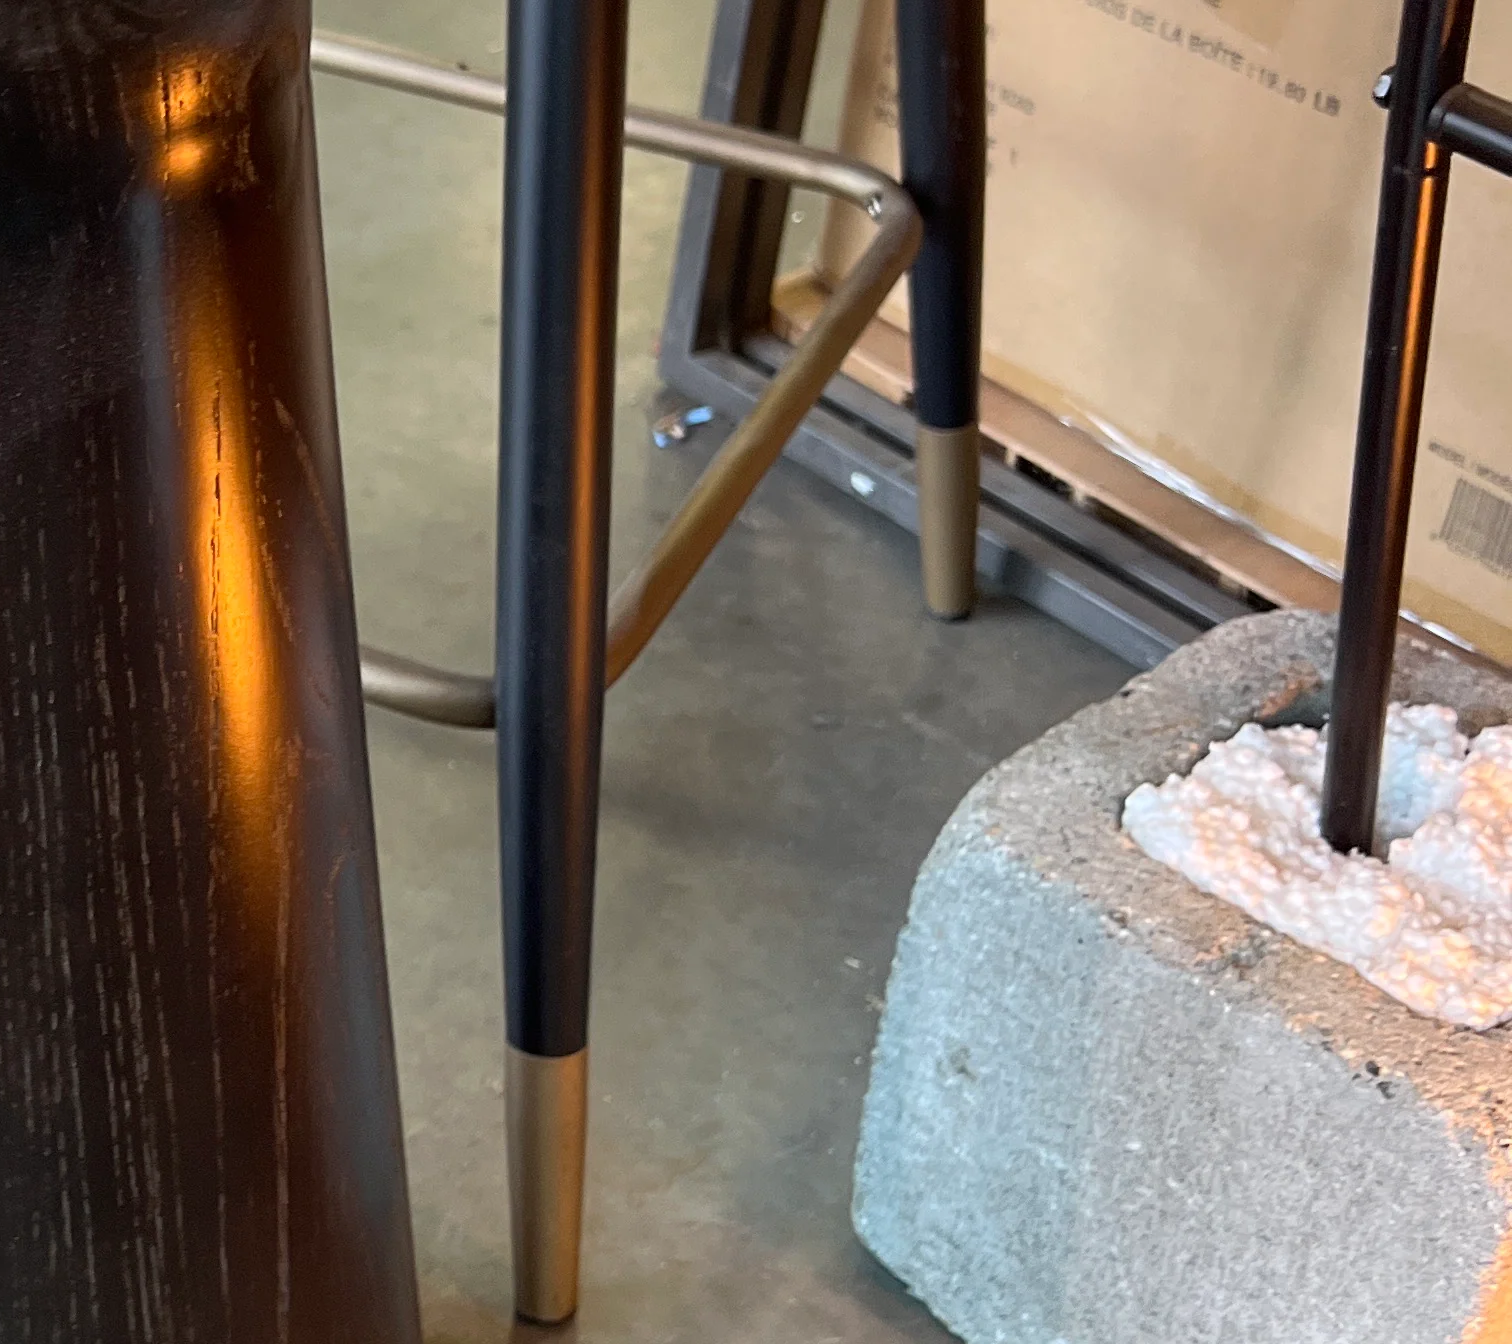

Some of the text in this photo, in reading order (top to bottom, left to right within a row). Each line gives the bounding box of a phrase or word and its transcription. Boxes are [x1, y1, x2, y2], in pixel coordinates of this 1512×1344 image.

[1130, 8, 1156, 34] DE
[1159, 19, 1184, 47] LA
[1312, 90, 1341, 117] LB
